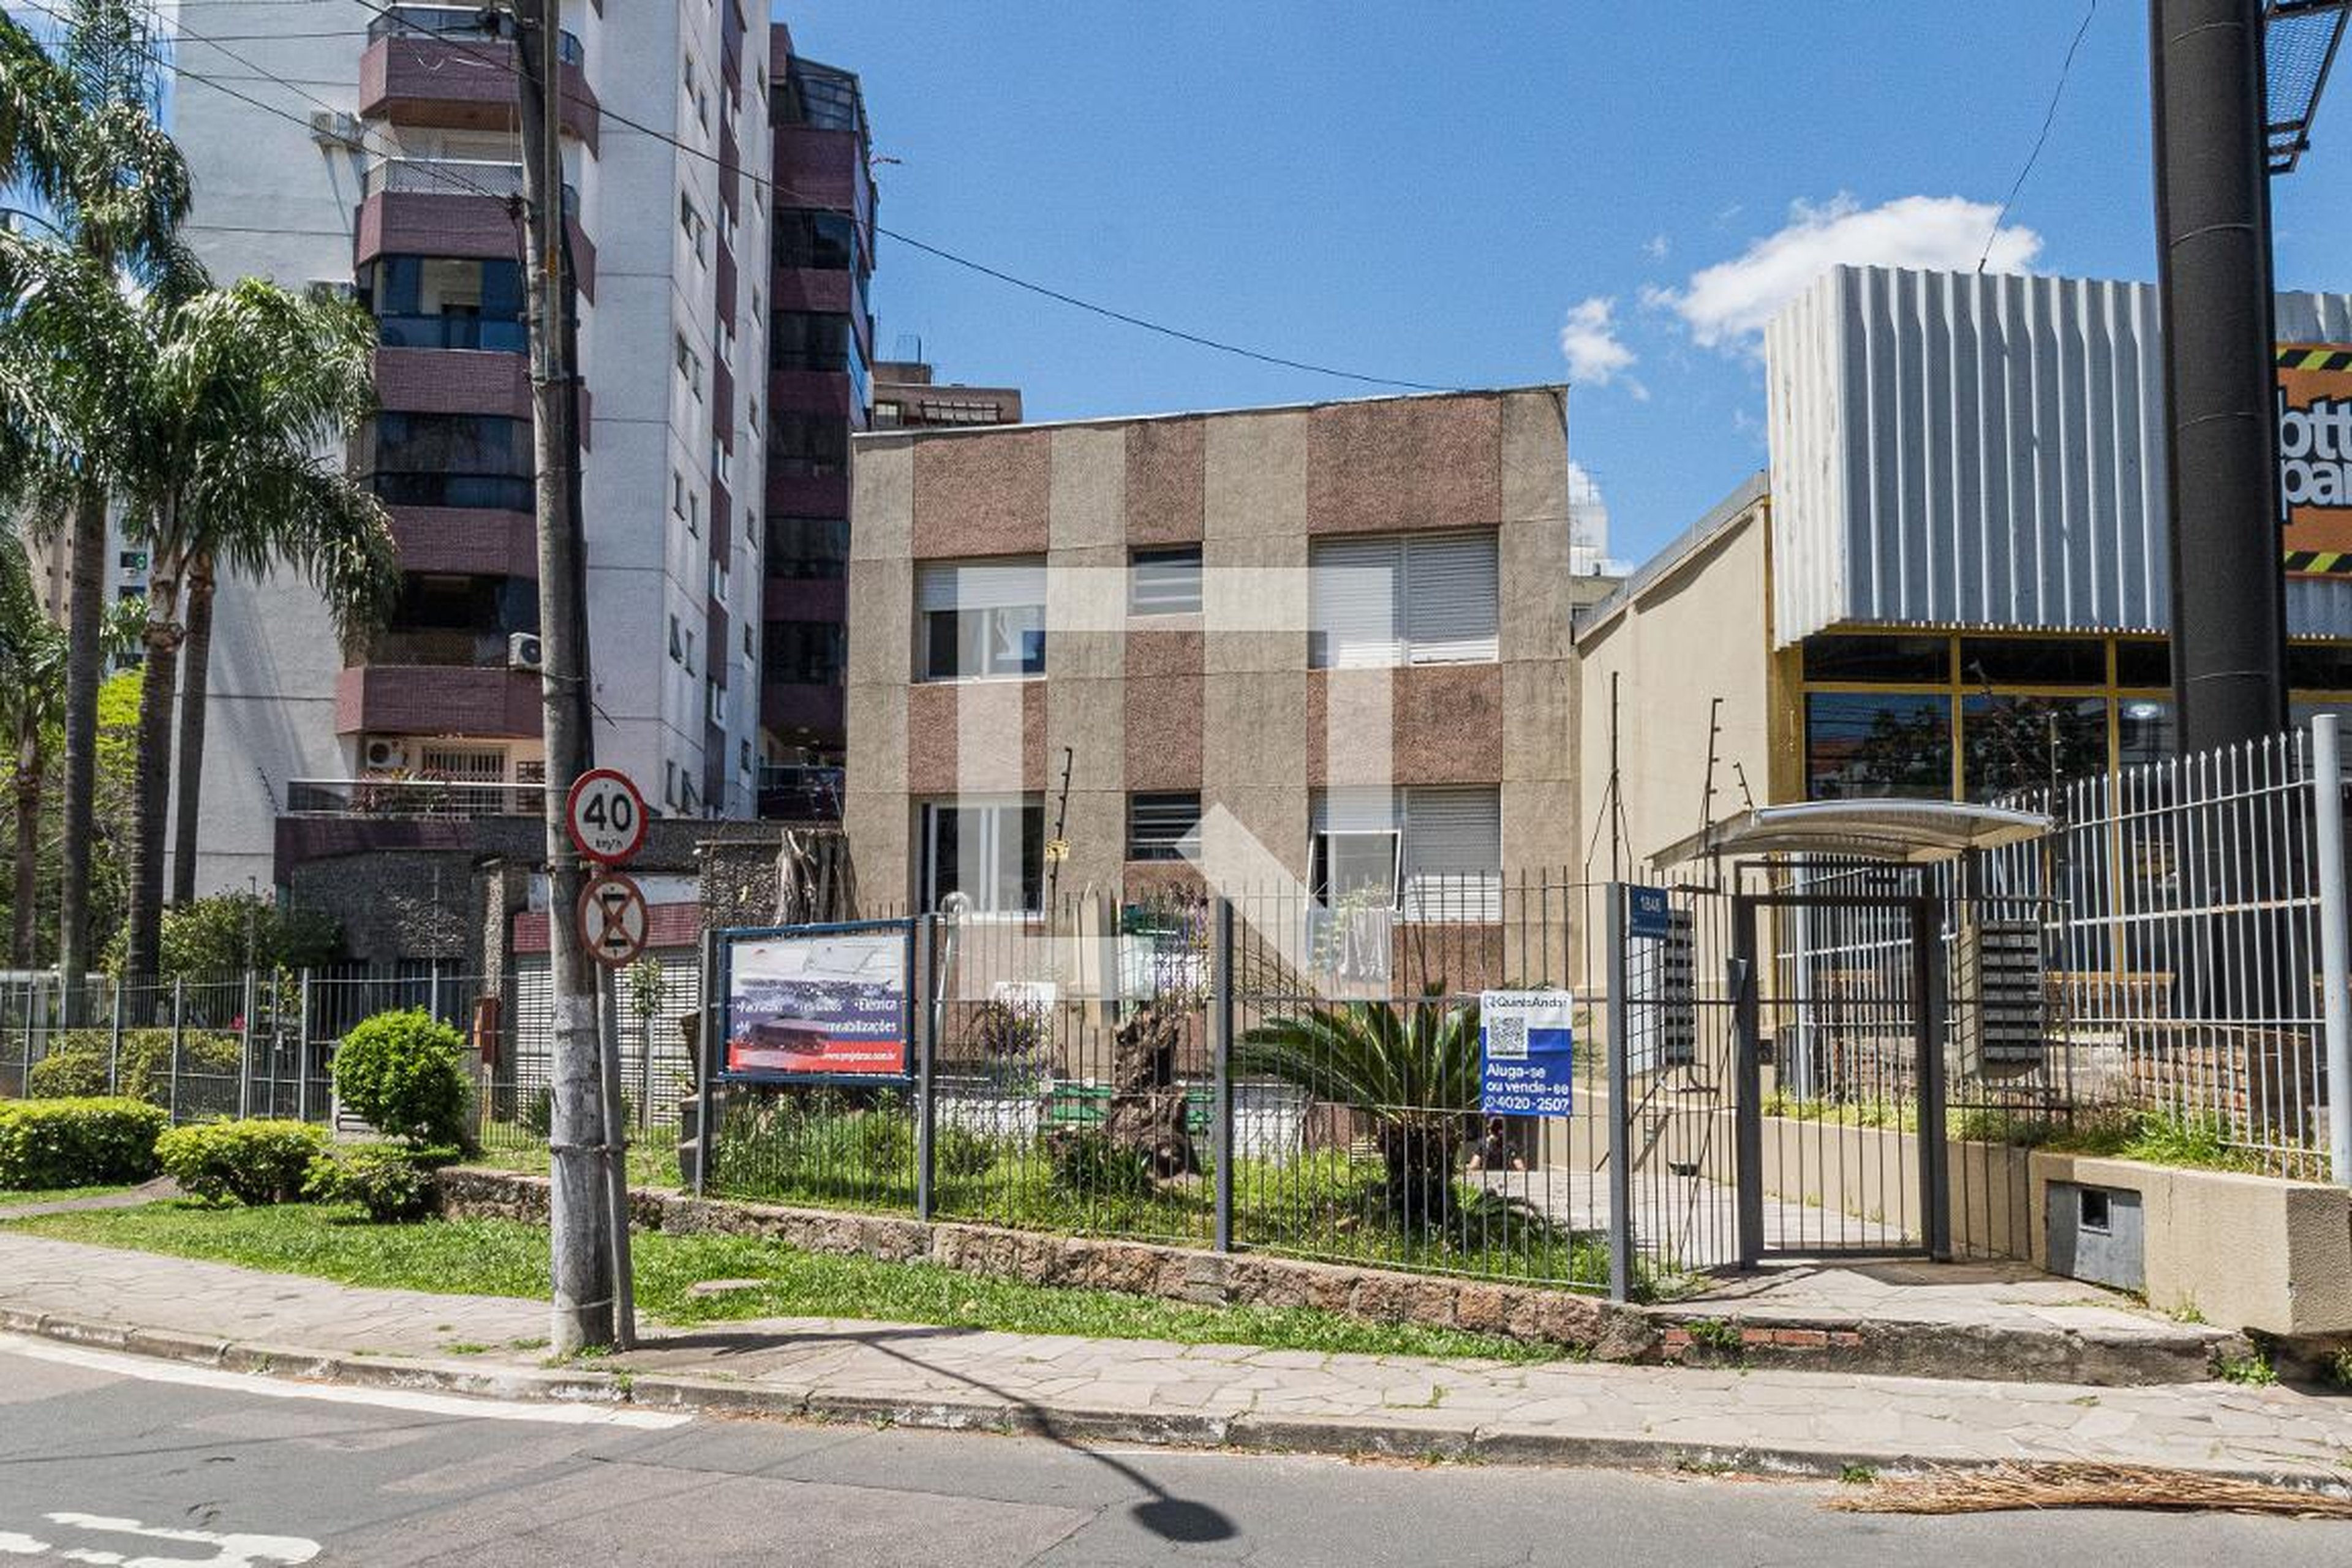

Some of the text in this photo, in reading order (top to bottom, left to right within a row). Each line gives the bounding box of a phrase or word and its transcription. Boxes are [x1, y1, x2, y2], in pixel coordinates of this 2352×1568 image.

[584, 792, 631, 832] 40
[595, 838, 624, 850] km/h
[1496, 996, 1567, 1008] QuintoAndar
[1486, 1063, 1546, 1080] Aluga-se
[1486, 1081, 1503, 1092] ou
